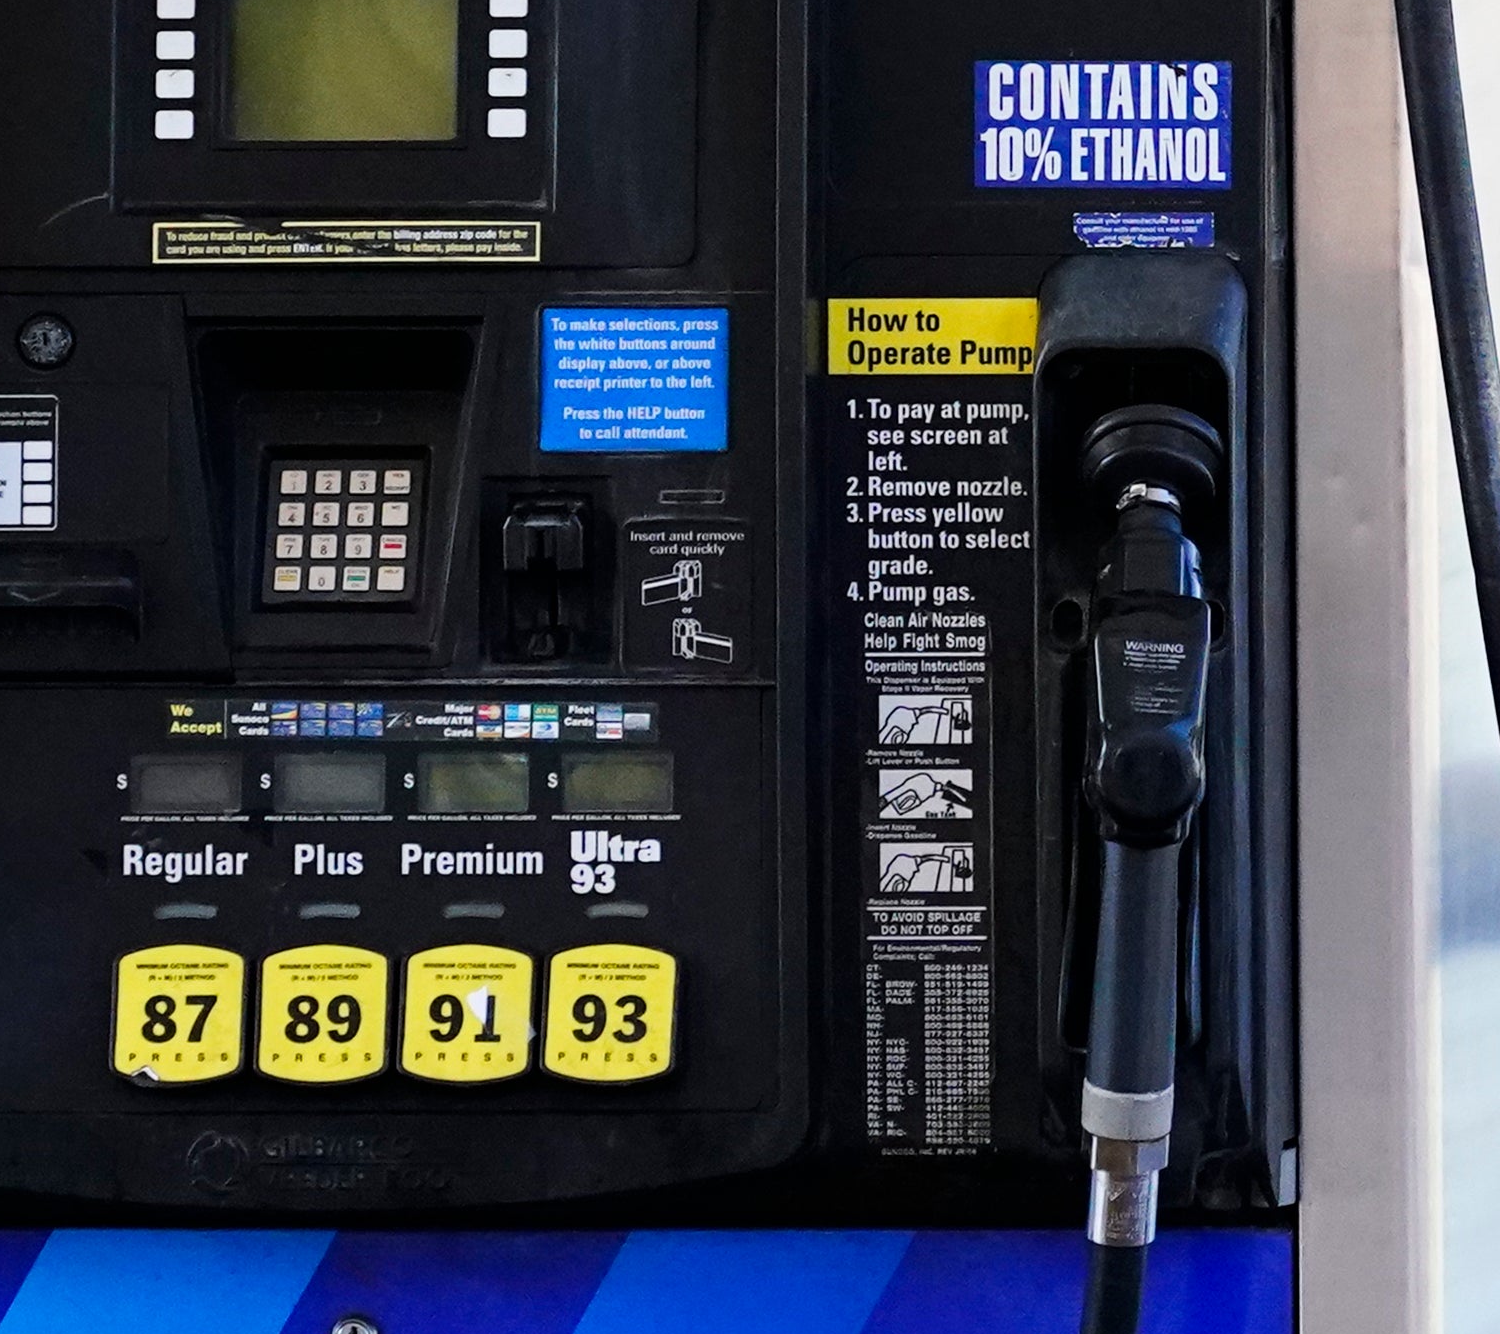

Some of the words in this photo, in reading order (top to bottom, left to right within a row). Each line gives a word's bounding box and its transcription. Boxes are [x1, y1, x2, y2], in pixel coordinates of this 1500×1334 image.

[988, 63, 1219, 120] CONTAINS
[980, 127, 1061, 182] 10%
[1072, 127, 1226, 182] ETHANOL
[551, 318, 567, 331] To
[570, 318, 606, 331] make
[609, 318, 680, 332] selections,
[683, 320, 719, 333] press
[848, 307, 908, 332] How
[915, 310, 940, 332] to
[554, 337, 575, 350] the
[578, 337, 616, 350] white
[619, 337, 667, 350] buttons
[670, 337, 716, 350] around
[848, 340, 951, 372] Operate
[961, 340, 1033, 372] Pump
[558, 357, 606, 373] display
[609, 357, 652, 370] above,
[655, 359, 668, 369] or
[672, 357, 711, 369] above
[554, 376, 600, 392] receipt
[603, 376, 647, 392] printer
[650, 377, 663, 388] to
[666, 376, 687, 388] the
[691, 376, 715, 388] left.
[563, 406, 600, 420] Press
[603, 407, 623, 420] the
[627, 406, 662, 420] HELP
[664, 407, 705, 420] button
[847, 399, 863, 419] 1.
[867, 398, 891, 419] To
[898, 404, 935, 424] pay
[941, 400, 961, 419] at
[966, 404, 1029, 424] pump,
[579, 427, 592, 439] to
[595, 426, 620, 439] call
[624, 427, 688, 439] attendant.
[867, 430, 904, 445] see
[910, 430, 982, 445] screen
[988, 427, 1008, 445] at
[868, 451, 908, 471] left.
[847, 476, 863, 496] 2.
[868, 476, 950, 496] Remove
[957, 476, 1028, 496] nozzle.
[847, 502, 863, 522] 3.
[868, 502, 926, 522] Press
[932, 502, 1003, 527] yellow
[630, 531, 665, 541] Insert
[669, 531, 693, 541] and
[697, 532, 745, 541] remove
[868, 529, 933, 549] button
[939, 531, 959, 549] to
[965, 529, 1030, 549] select
[649, 544, 678, 554] card
[681, 544, 725, 556] quickly
[868, 555, 933, 579] grade.
[847, 582, 863, 601] 4.
[868, 582, 926, 606] Pump
[932, 586, 975, 606] gas.
[864, 612, 904, 628] Clean
[908, 612, 928, 628] Air
[932, 612, 986, 628] Nozzles
[864, 633, 897, 651] Help
[903, 633, 940, 652] Fight
[946, 632, 986, 651] Smog
[1126, 640, 1184, 654] WARNING
[865, 660, 919, 675] Operating
[921, 660, 986, 672] Instructions
[170, 705, 194, 717] We
[252, 702, 267, 712] All
[445, 703, 475, 715] Major
[568, 705, 595, 715] Fleet
[231, 714, 269, 724] Sunoco
[415, 716, 474, 726] Credit/ATM
[564, 717, 595, 727] Cards
[170, 722, 222, 735] Accept
[238, 727, 269, 736] Cards
[443, 728, 474, 738] Cards
[570, 830, 661, 863] Ultra
[123, 844, 249, 883] Regular
[294, 843, 364, 875] Plus
[401, 843, 544, 875] Premium
[570, 863, 616, 894] 93
[873, 913, 888, 922] TO
[891, 913, 924, 922] AVOID
[928, 913, 981, 922] SPILLAGE
[881, 925, 897, 935] DO
[900, 925, 923, 935] NOT
[926, 925, 949, 935] TOP
[952, 925, 973, 935] OFF
[141, 995, 218, 1043] 87
[285, 995, 361, 1043] 89
[429, 994, 501, 1043] 91
[572, 994, 647, 1043] 93
